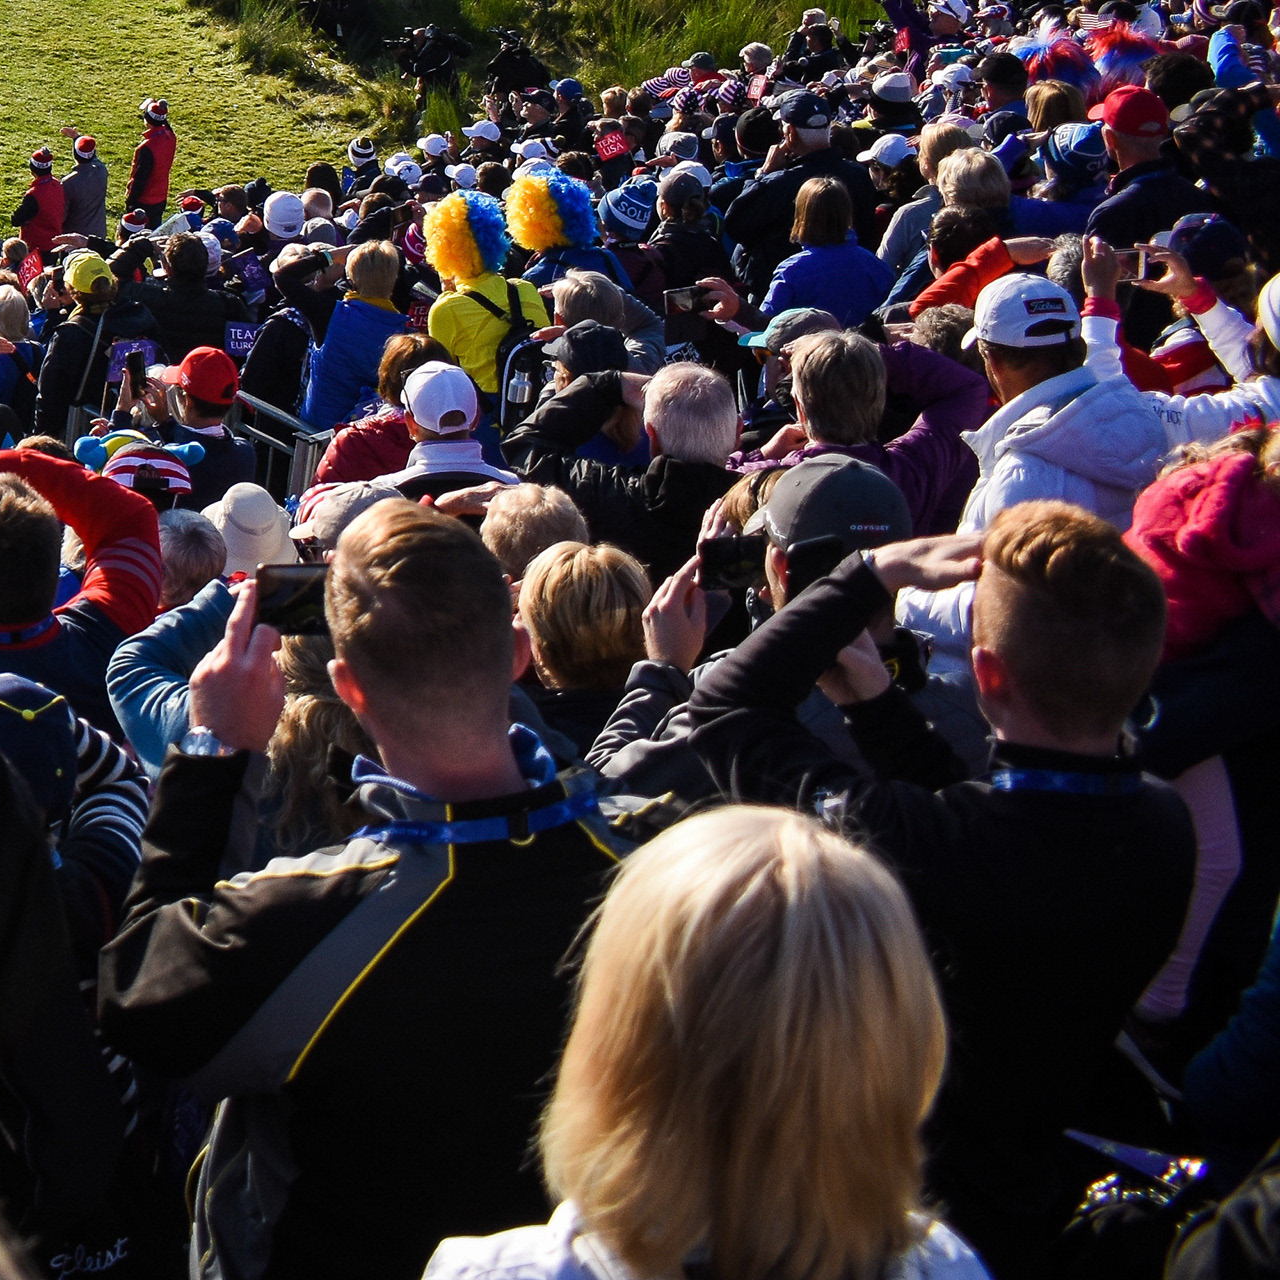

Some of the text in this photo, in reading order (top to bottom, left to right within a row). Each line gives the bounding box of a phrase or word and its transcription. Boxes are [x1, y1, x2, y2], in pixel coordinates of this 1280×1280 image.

[597, 133, 622, 149] TEAM
[602, 142, 624, 156] USA
[1030, 300, 1063, 313] Titleist
